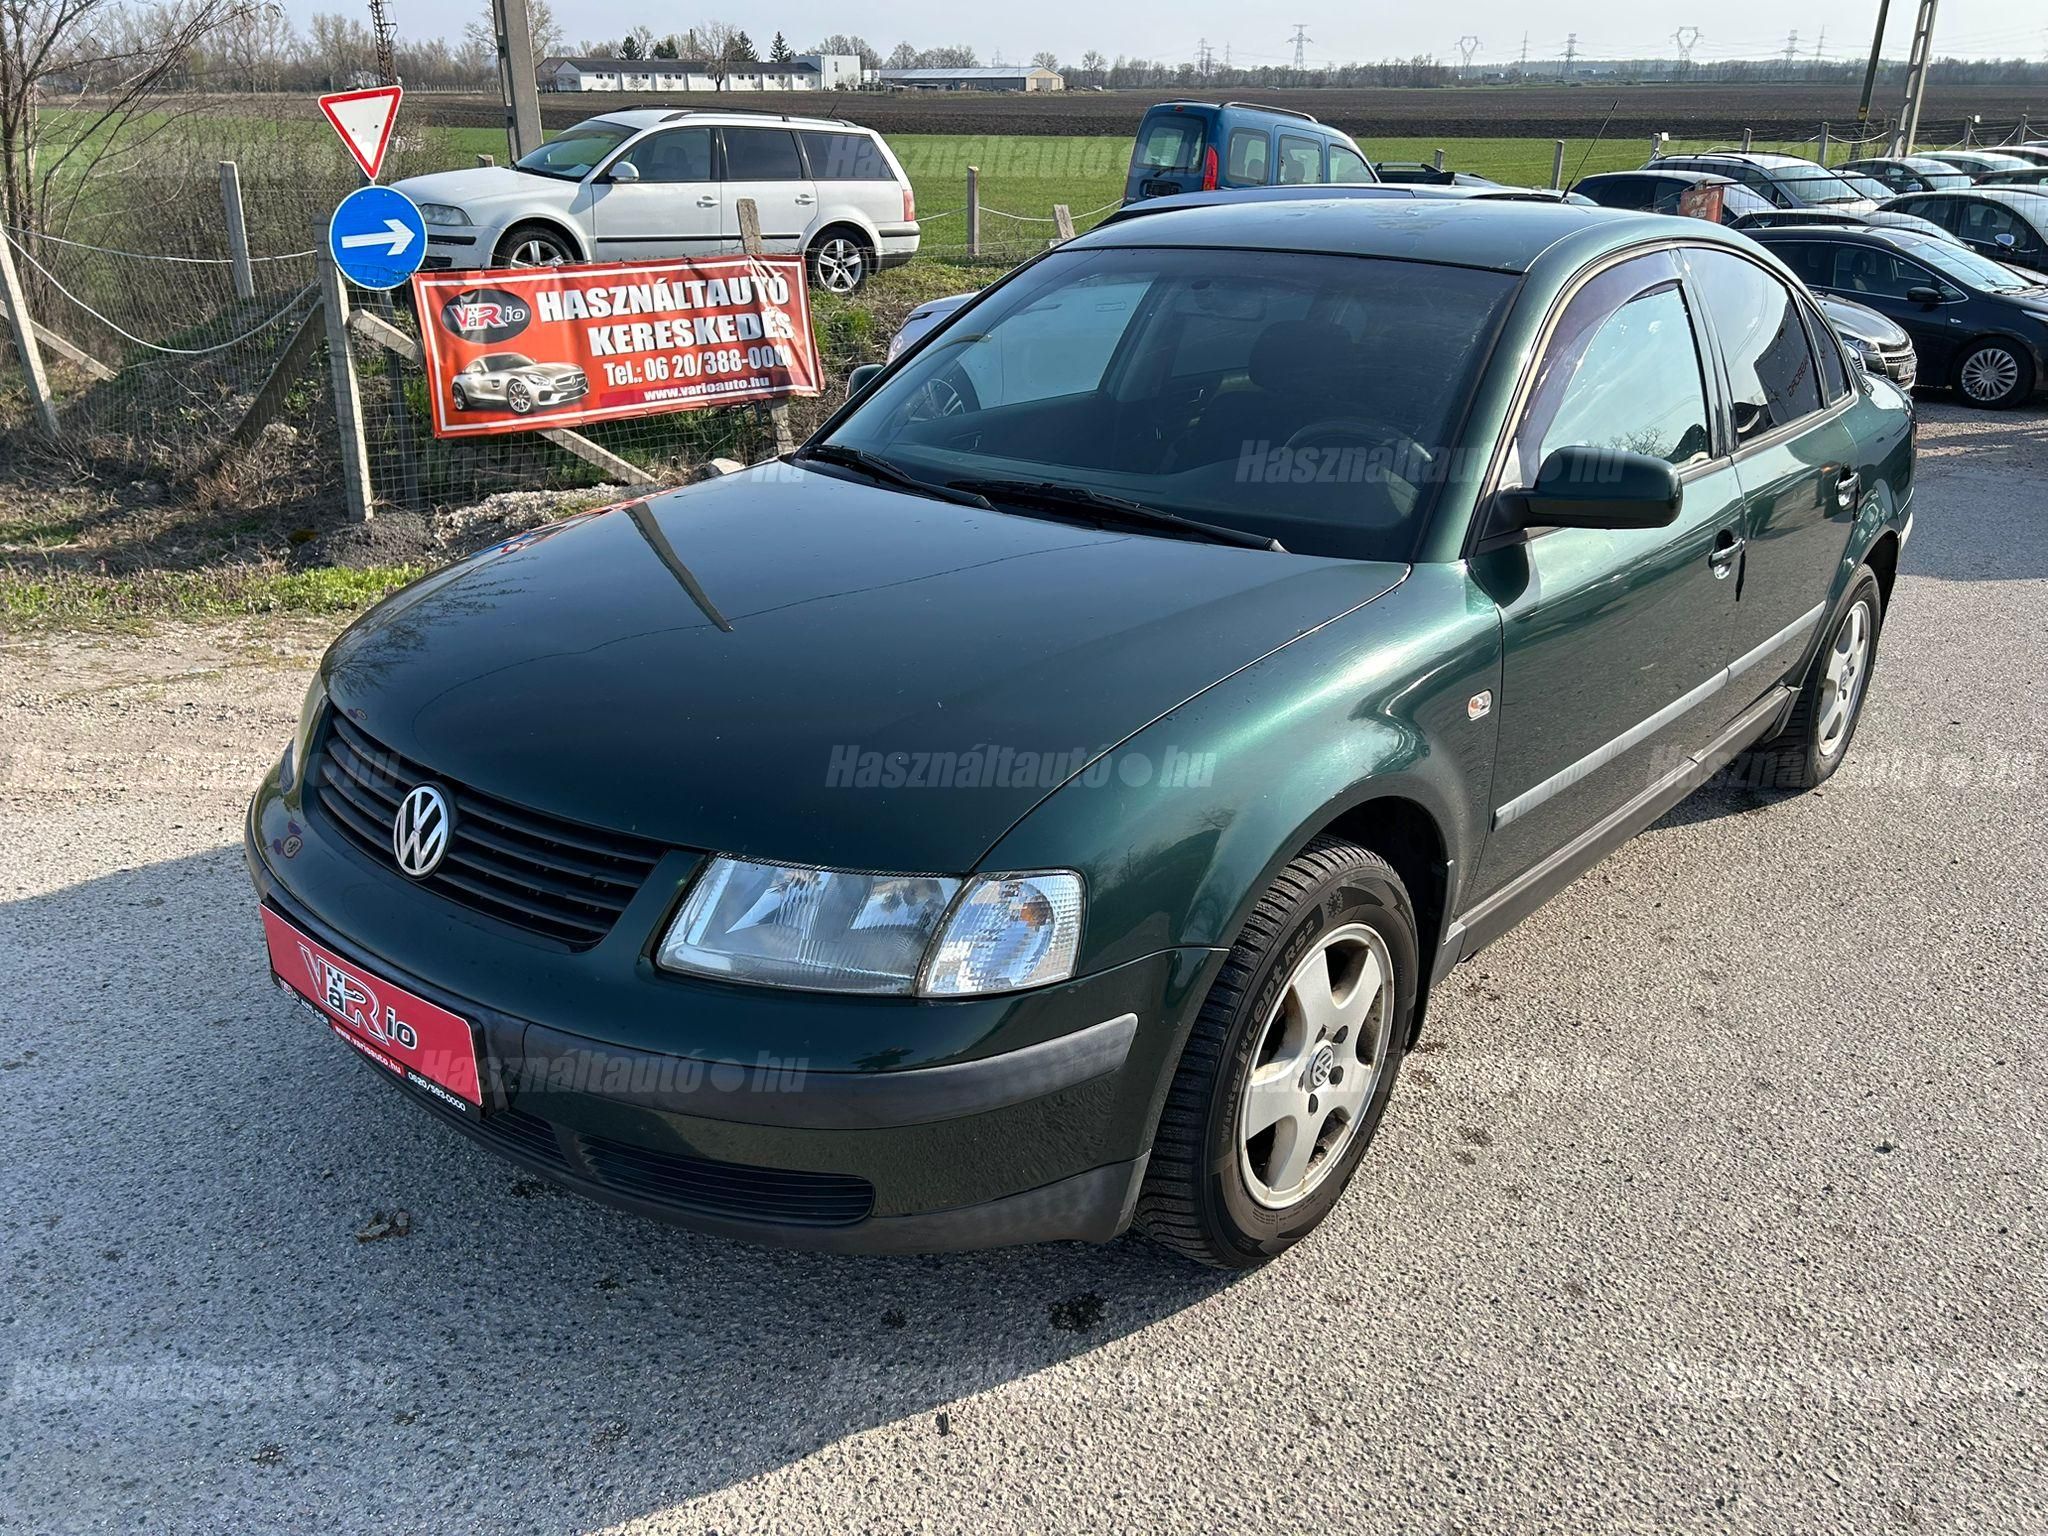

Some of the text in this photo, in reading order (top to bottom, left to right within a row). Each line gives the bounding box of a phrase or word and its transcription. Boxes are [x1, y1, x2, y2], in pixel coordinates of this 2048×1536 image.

[536, 272, 790, 322] HASZNÁLTAUTÓ
[587, 307, 794, 357] KERESKEDÉS
[644, 354, 669, 381] 06
[643, 376, 770, 401] www.varioauto.hu
